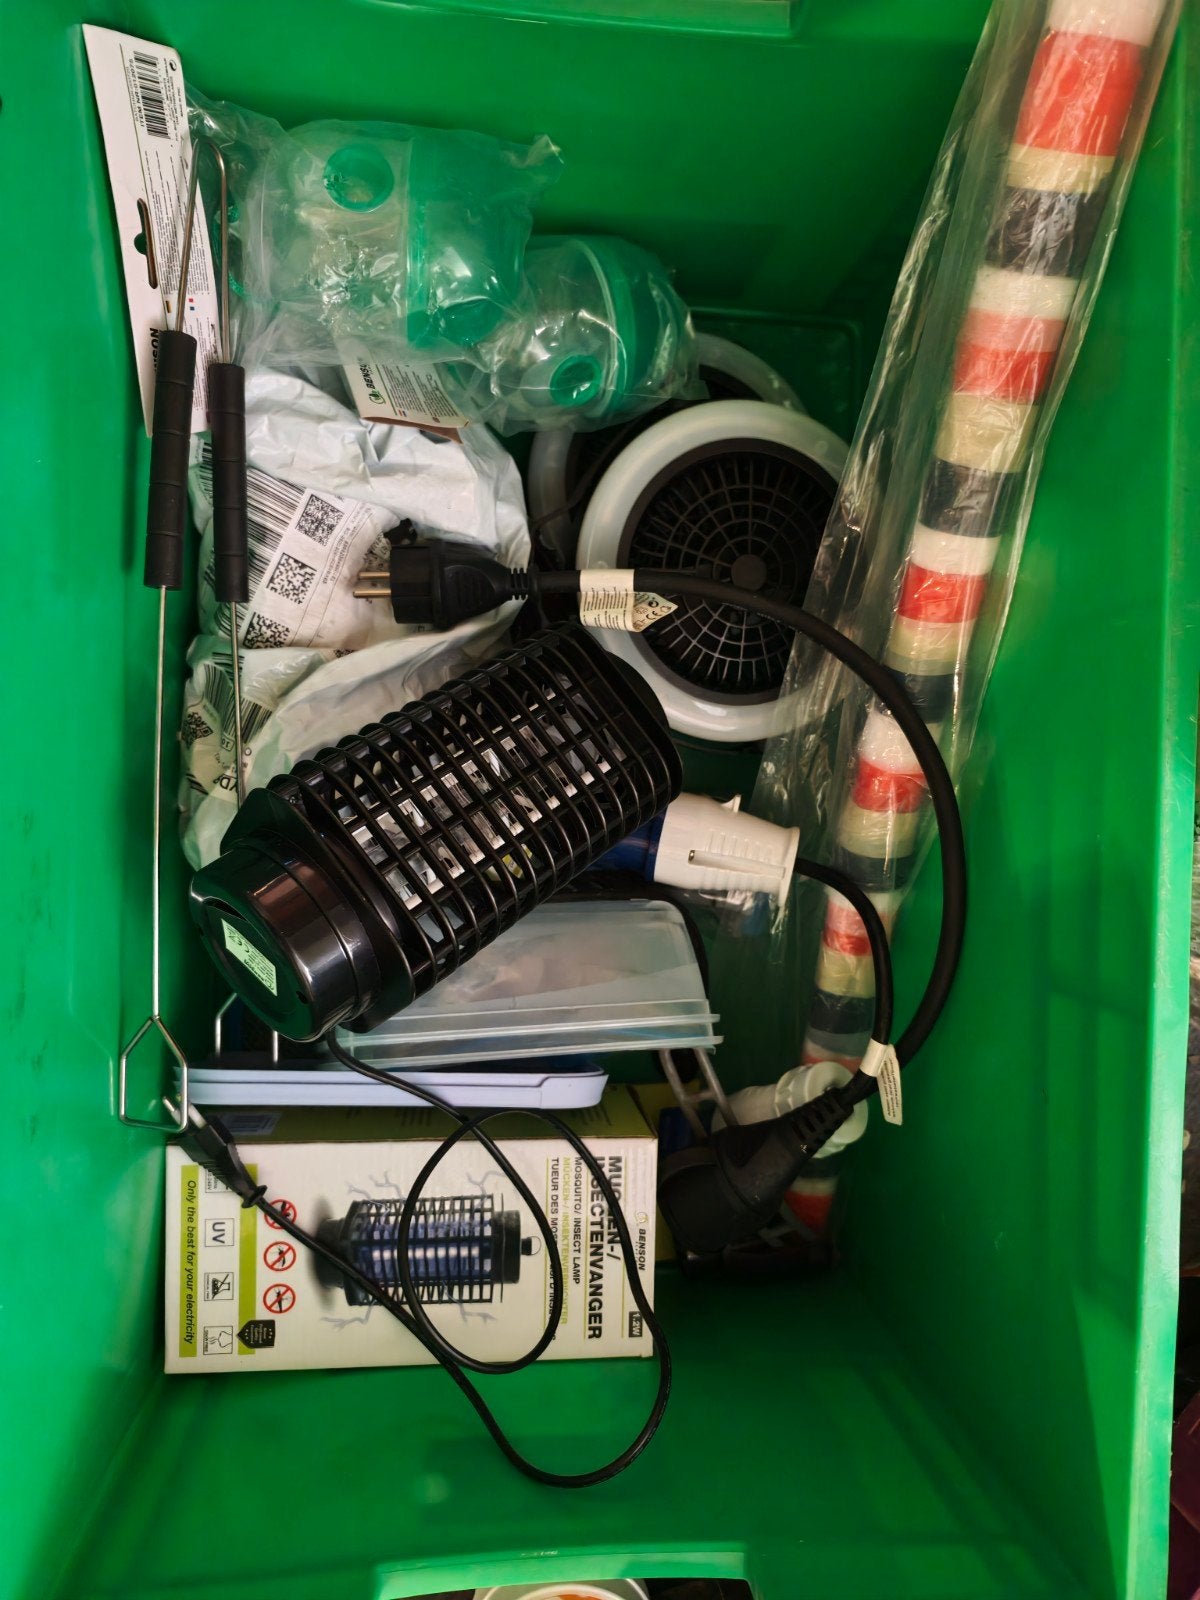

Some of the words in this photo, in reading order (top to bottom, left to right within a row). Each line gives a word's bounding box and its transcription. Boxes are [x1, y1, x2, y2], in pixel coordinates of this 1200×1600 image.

[550, 1158, 559, 1191] TUEUR
[186, 1180, 197, 1204] Only
[550, 1194, 559, 1215] DES
[187, 1206, 196, 1223] the
[187, 1225, 196, 1249] best
[212, 1222, 226, 1244] UV
[573, 1217, 581, 1254] INSECT
[186, 1251, 196, 1266] for
[588, 1156, 605, 1340] ISECTENVANGER
[638, 1228, 647, 1271] BENSON
[184, 1267, 194, 1292] your
[572, 1256, 581, 1285] LAMP
[183, 1293, 196, 1345] electricity
[632, 1311, 641, 1336] 1.2W
